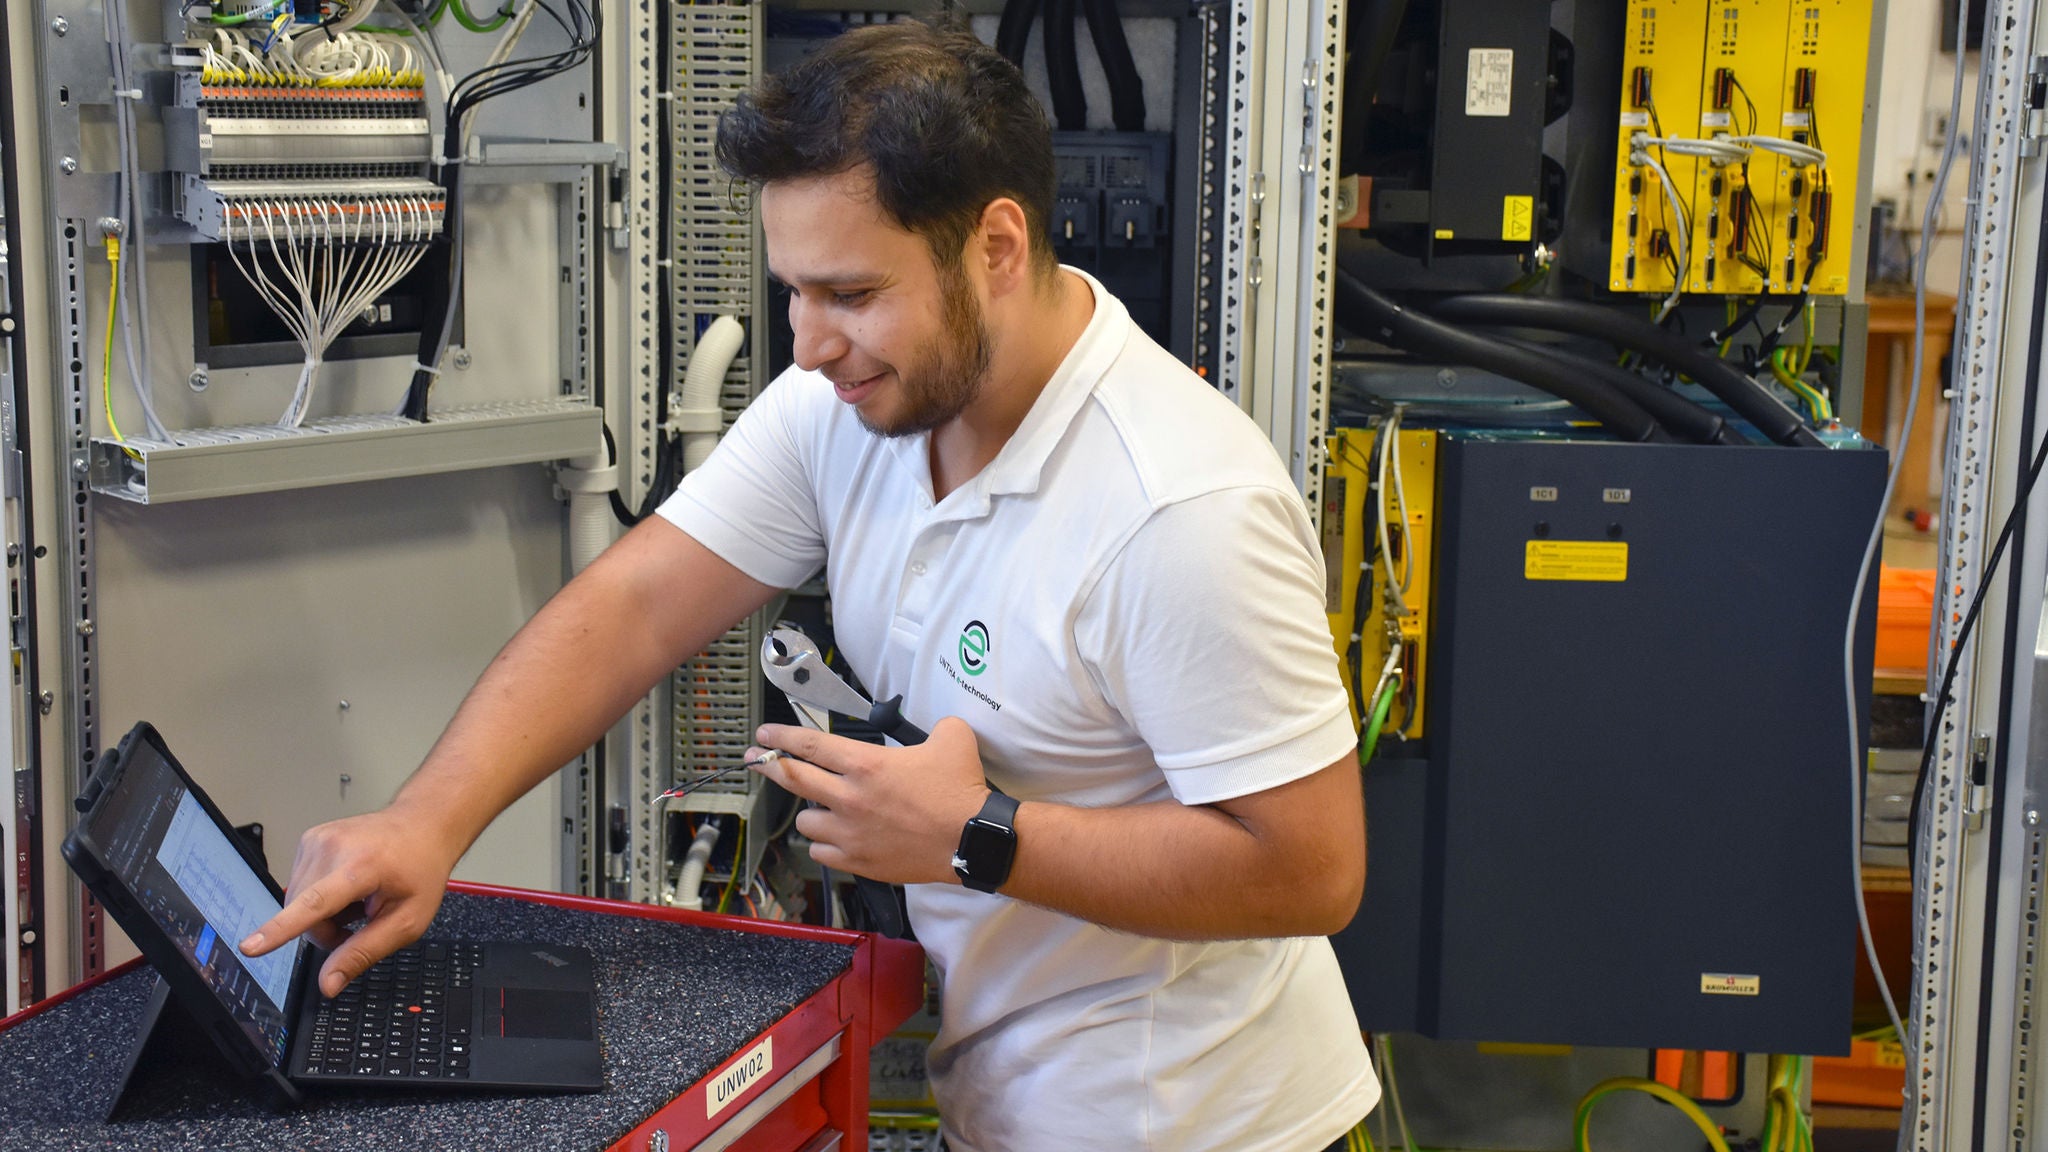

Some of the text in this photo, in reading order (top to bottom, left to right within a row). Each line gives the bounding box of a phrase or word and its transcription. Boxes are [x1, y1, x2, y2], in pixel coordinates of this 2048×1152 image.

[1535, 489, 1553, 498] 1C1
[939, 655, 1002, 711] UNTHA e-technology
[717, 1052, 763, 1102] UNW02
